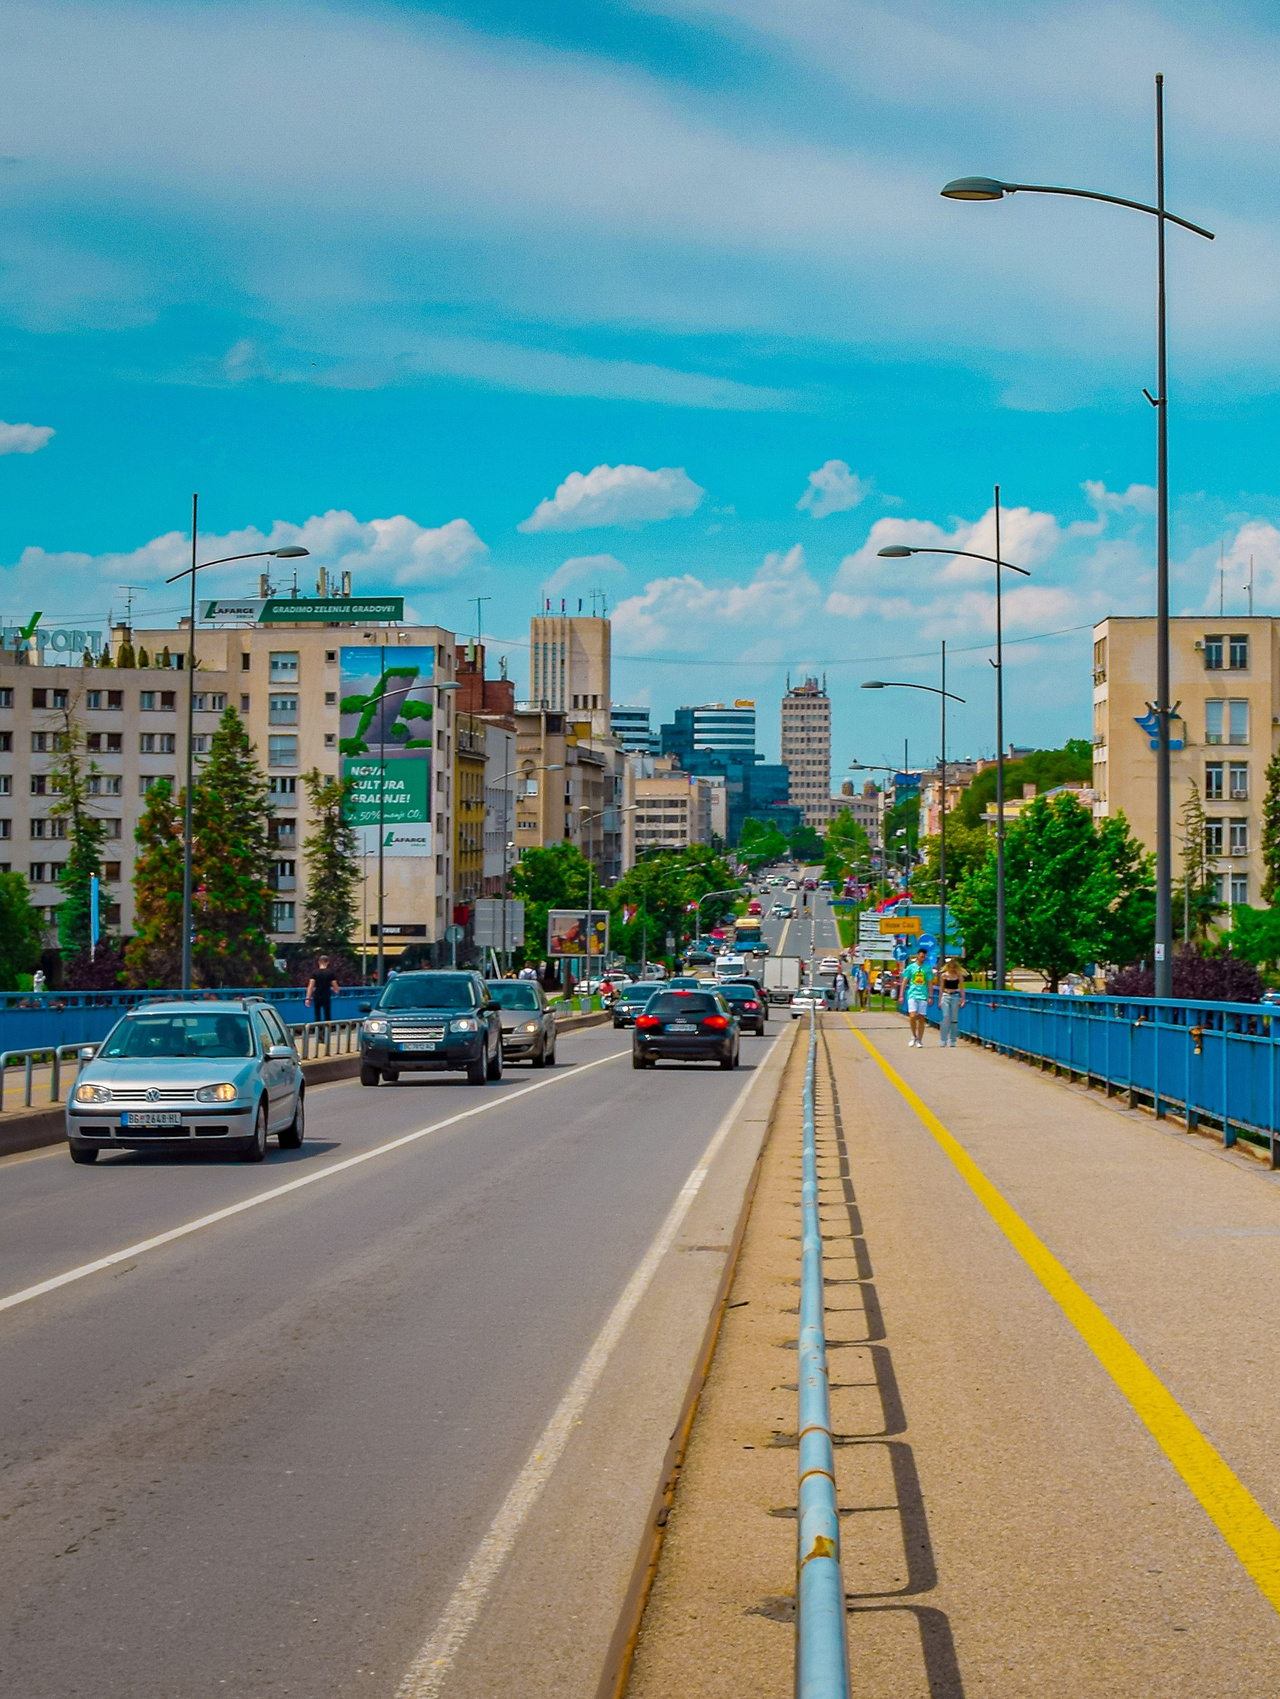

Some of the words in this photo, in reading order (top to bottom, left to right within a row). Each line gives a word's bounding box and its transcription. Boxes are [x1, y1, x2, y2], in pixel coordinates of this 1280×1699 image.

[272, 605, 313, 613] GRADIMO
[352, 605, 395, 613] GRADOVE!
[350, 766, 386, 776] NOVA
